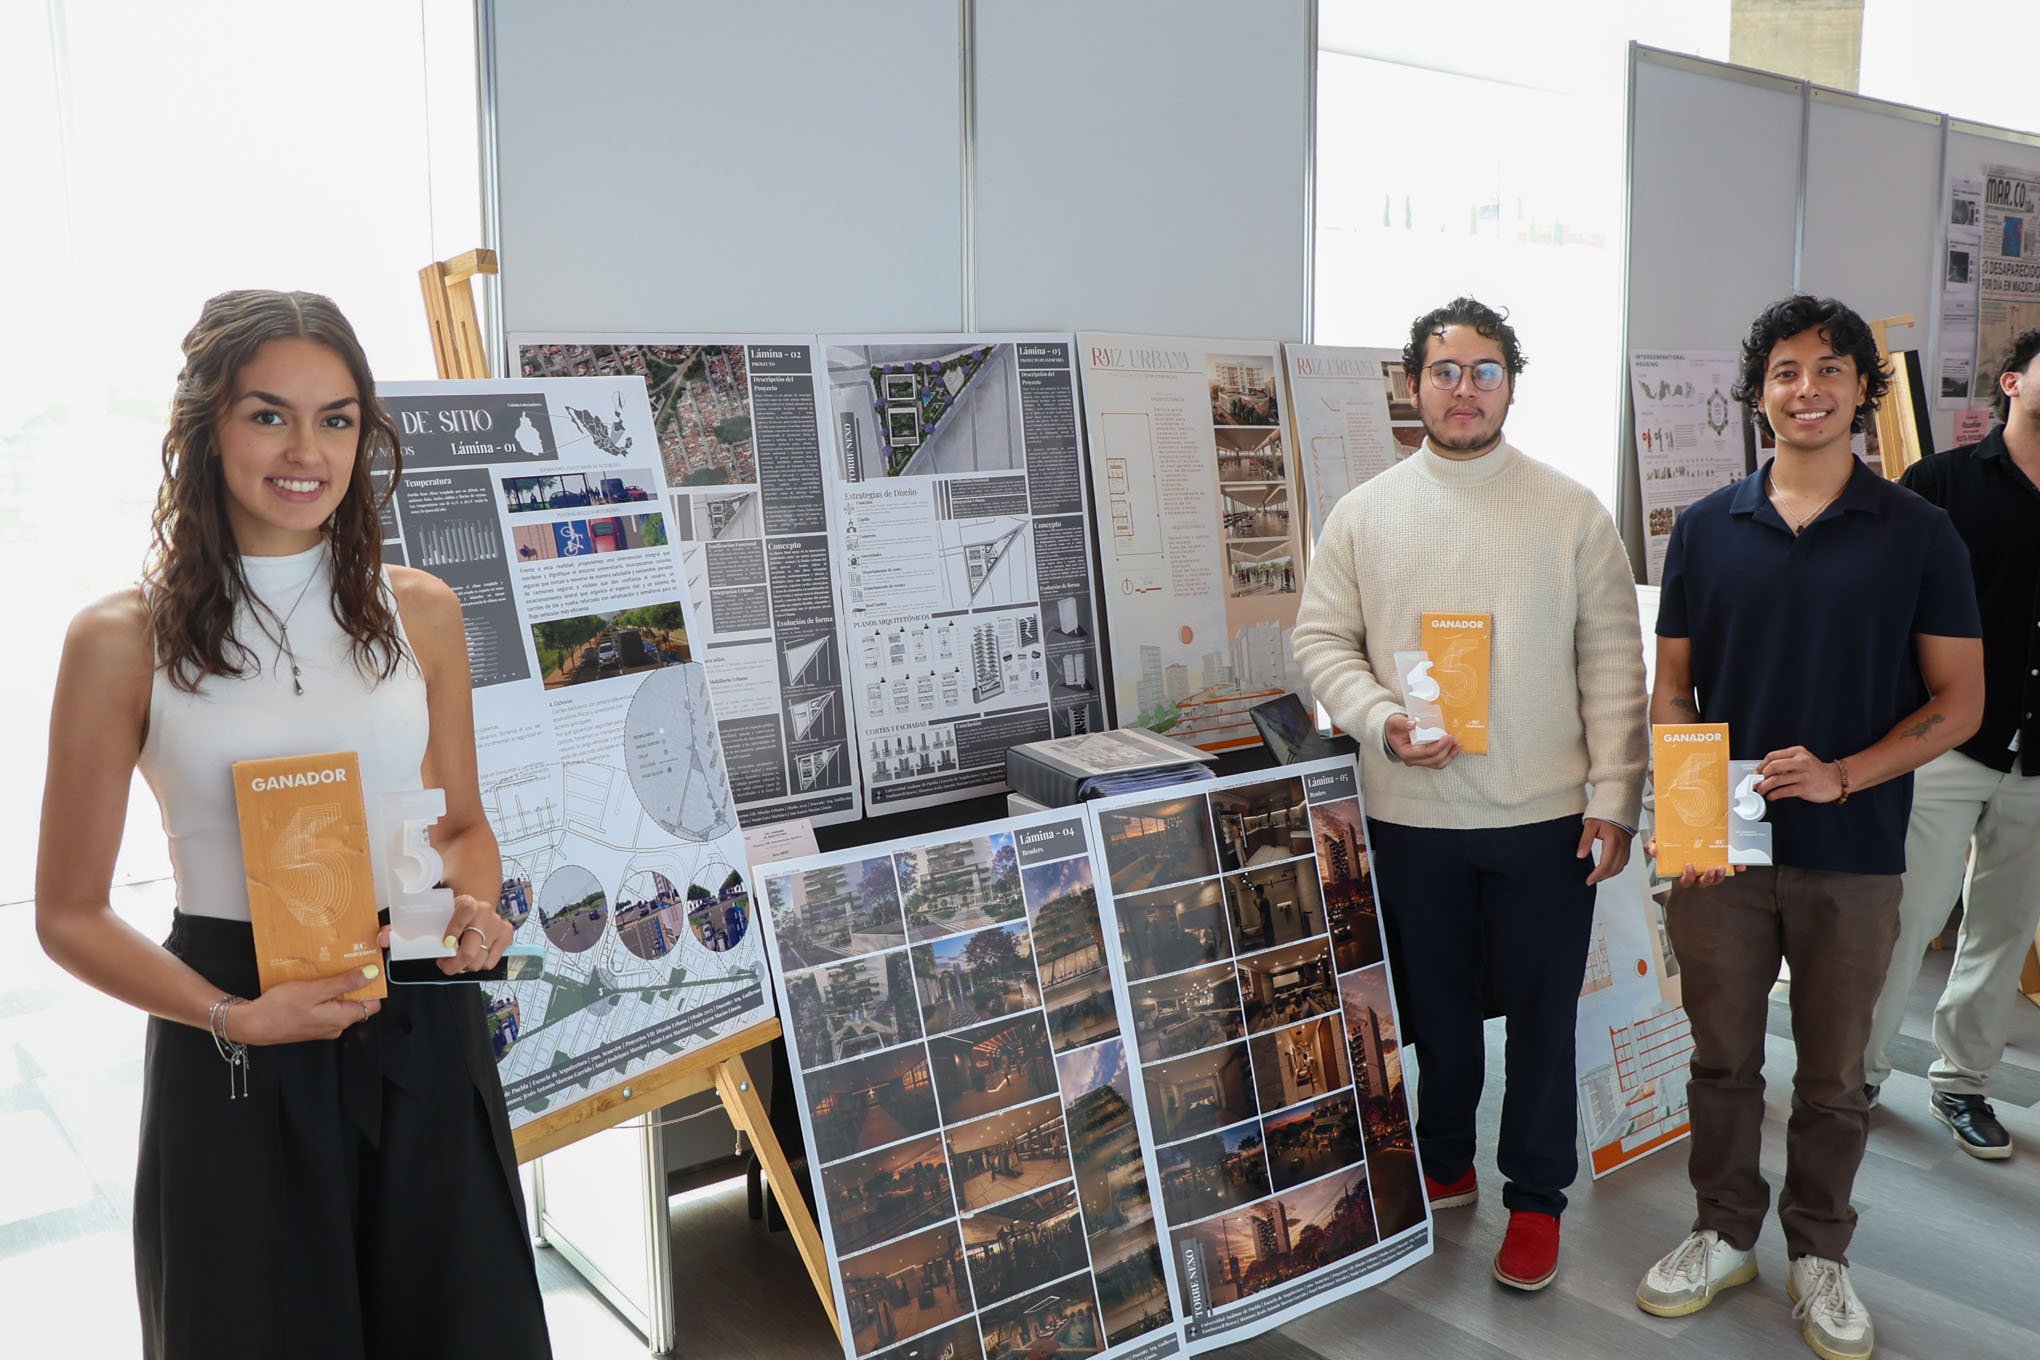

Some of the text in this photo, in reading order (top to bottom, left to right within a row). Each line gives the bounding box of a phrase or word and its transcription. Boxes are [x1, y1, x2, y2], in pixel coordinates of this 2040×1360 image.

[2004, 280, 2011, 291] EN
[2013, 281, 2040, 293] MAZATLA
[751, 348, 782, 358] Lámina
[1019, 346, 1046, 356] Lámina
[1052, 348, 1062, 356] 03
[754, 376, 784, 384] Descripción
[401, 409, 493, 434] DE SITIO
[844, 423, 854, 448] NEXO
[451, 441, 494, 456] Lámina
[404, 478, 452, 488] Temperatura
[845, 490, 883, 500] Estrategias
[894, 488, 917, 497] Diseño
[1034, 521, 1061, 529] Concepto
[768, 542, 801, 550] Concepto
[776, 618, 806, 627] Evolución
[816, 616, 833, 624] forma
[1431, 620, 1484, 629] GANADOR
[866, 726, 890, 735] CORTES
[896, 721, 927, 731] FACHADAS
[1664, 733, 1722, 742] GANADOR
[251, 768, 347, 792] GANADOR
[1308, 776, 1334, 788] Lámina
[1340, 774, 1348, 782] 05
[1020, 830, 1054, 844] Lámina
[1062, 827, 1074, 836] 04
[1022, 848, 1044, 856] Renders
[511, 1084, 528, 1095] Puebla
[532, 1075, 551, 1086] Escuela
[1186, 1249, 1203, 1318] TORRE NEXO
